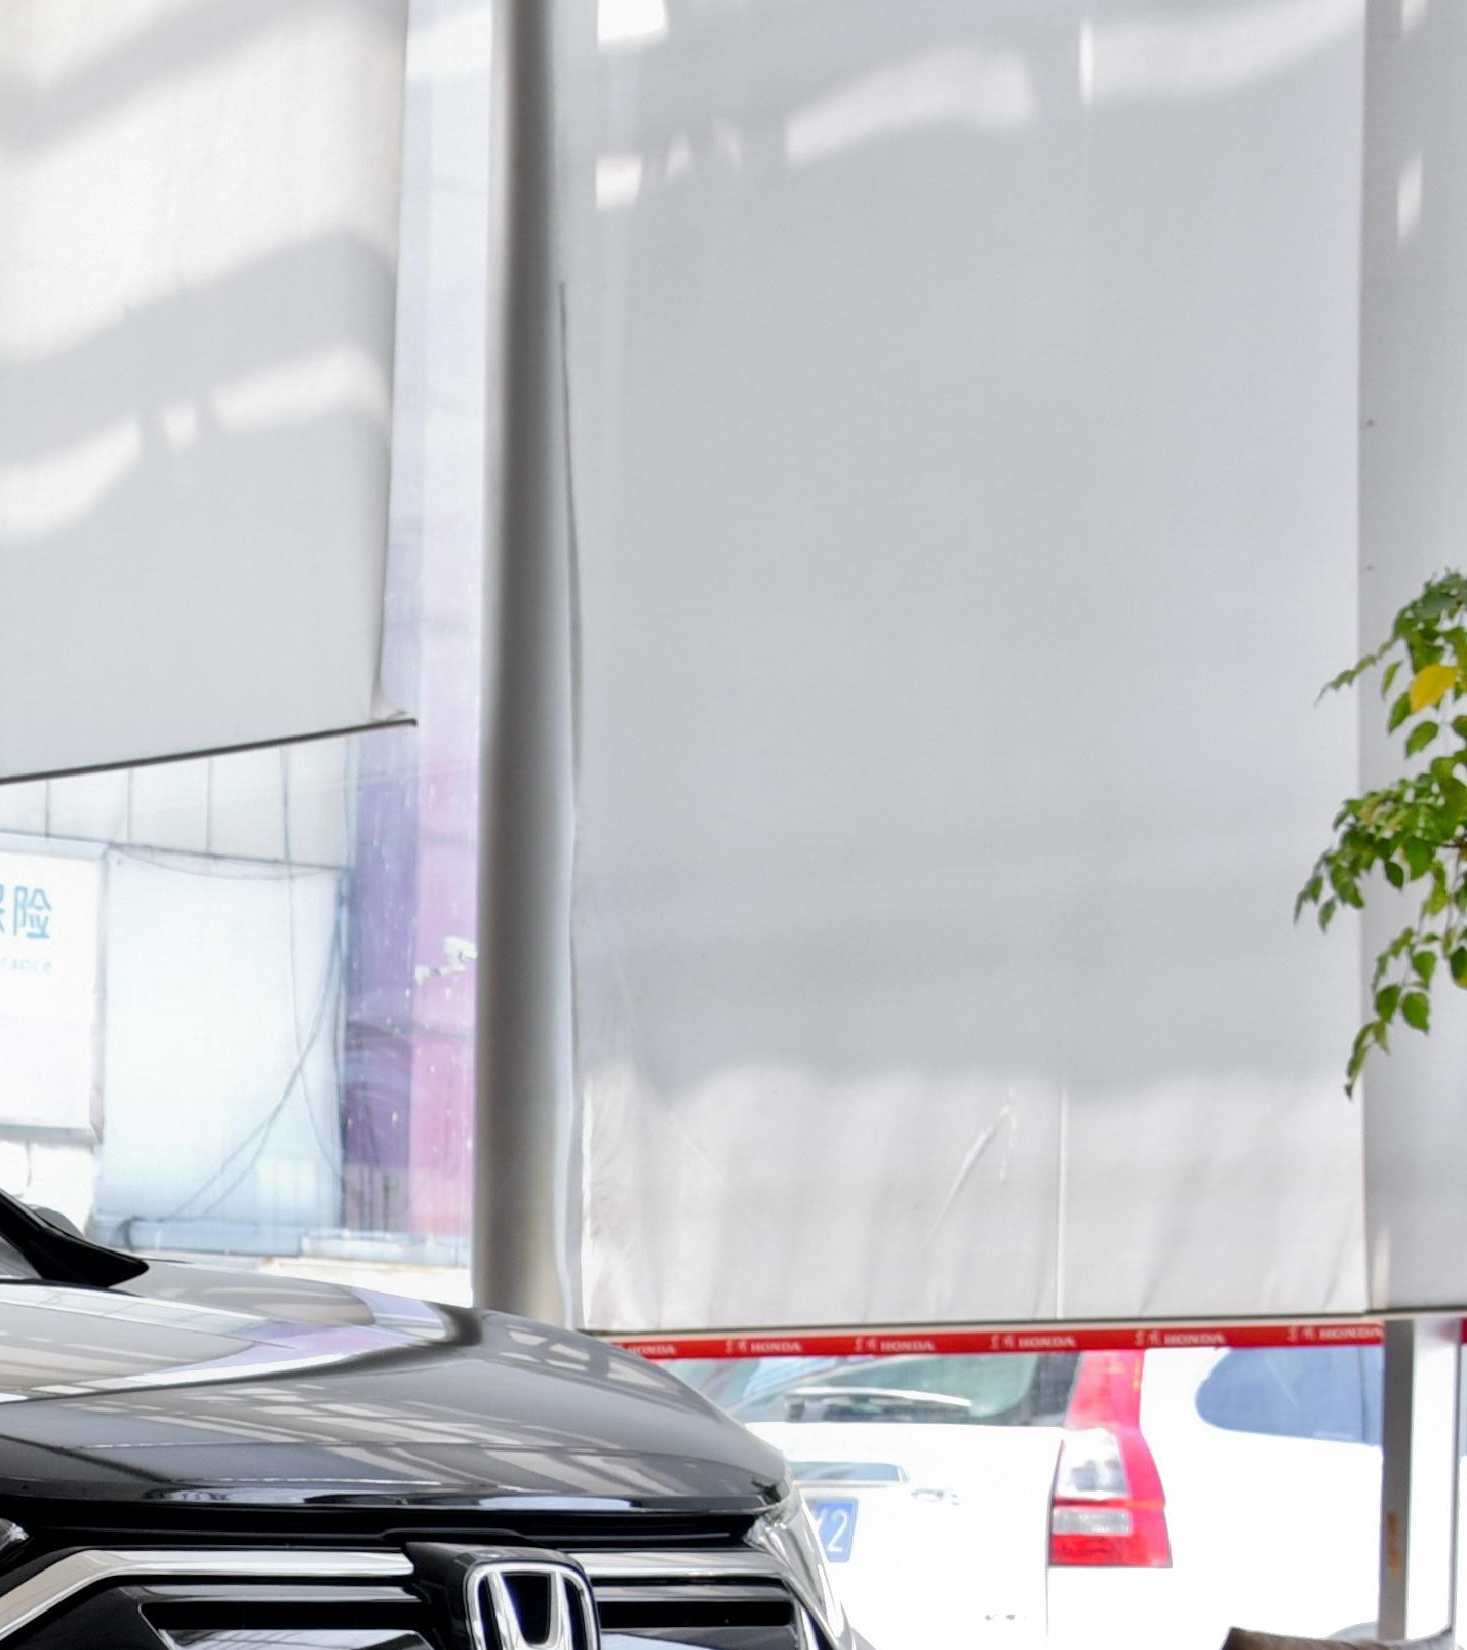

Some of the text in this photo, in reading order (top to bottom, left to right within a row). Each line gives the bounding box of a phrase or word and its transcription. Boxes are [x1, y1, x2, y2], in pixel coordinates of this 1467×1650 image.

[1018, 1335, 1077, 1348] HONDA
[1164, 1332, 1226, 1346] HONDA
[750, 1341, 802, 1353] HONDA
[880, 1340, 935, 1353] HONDA
